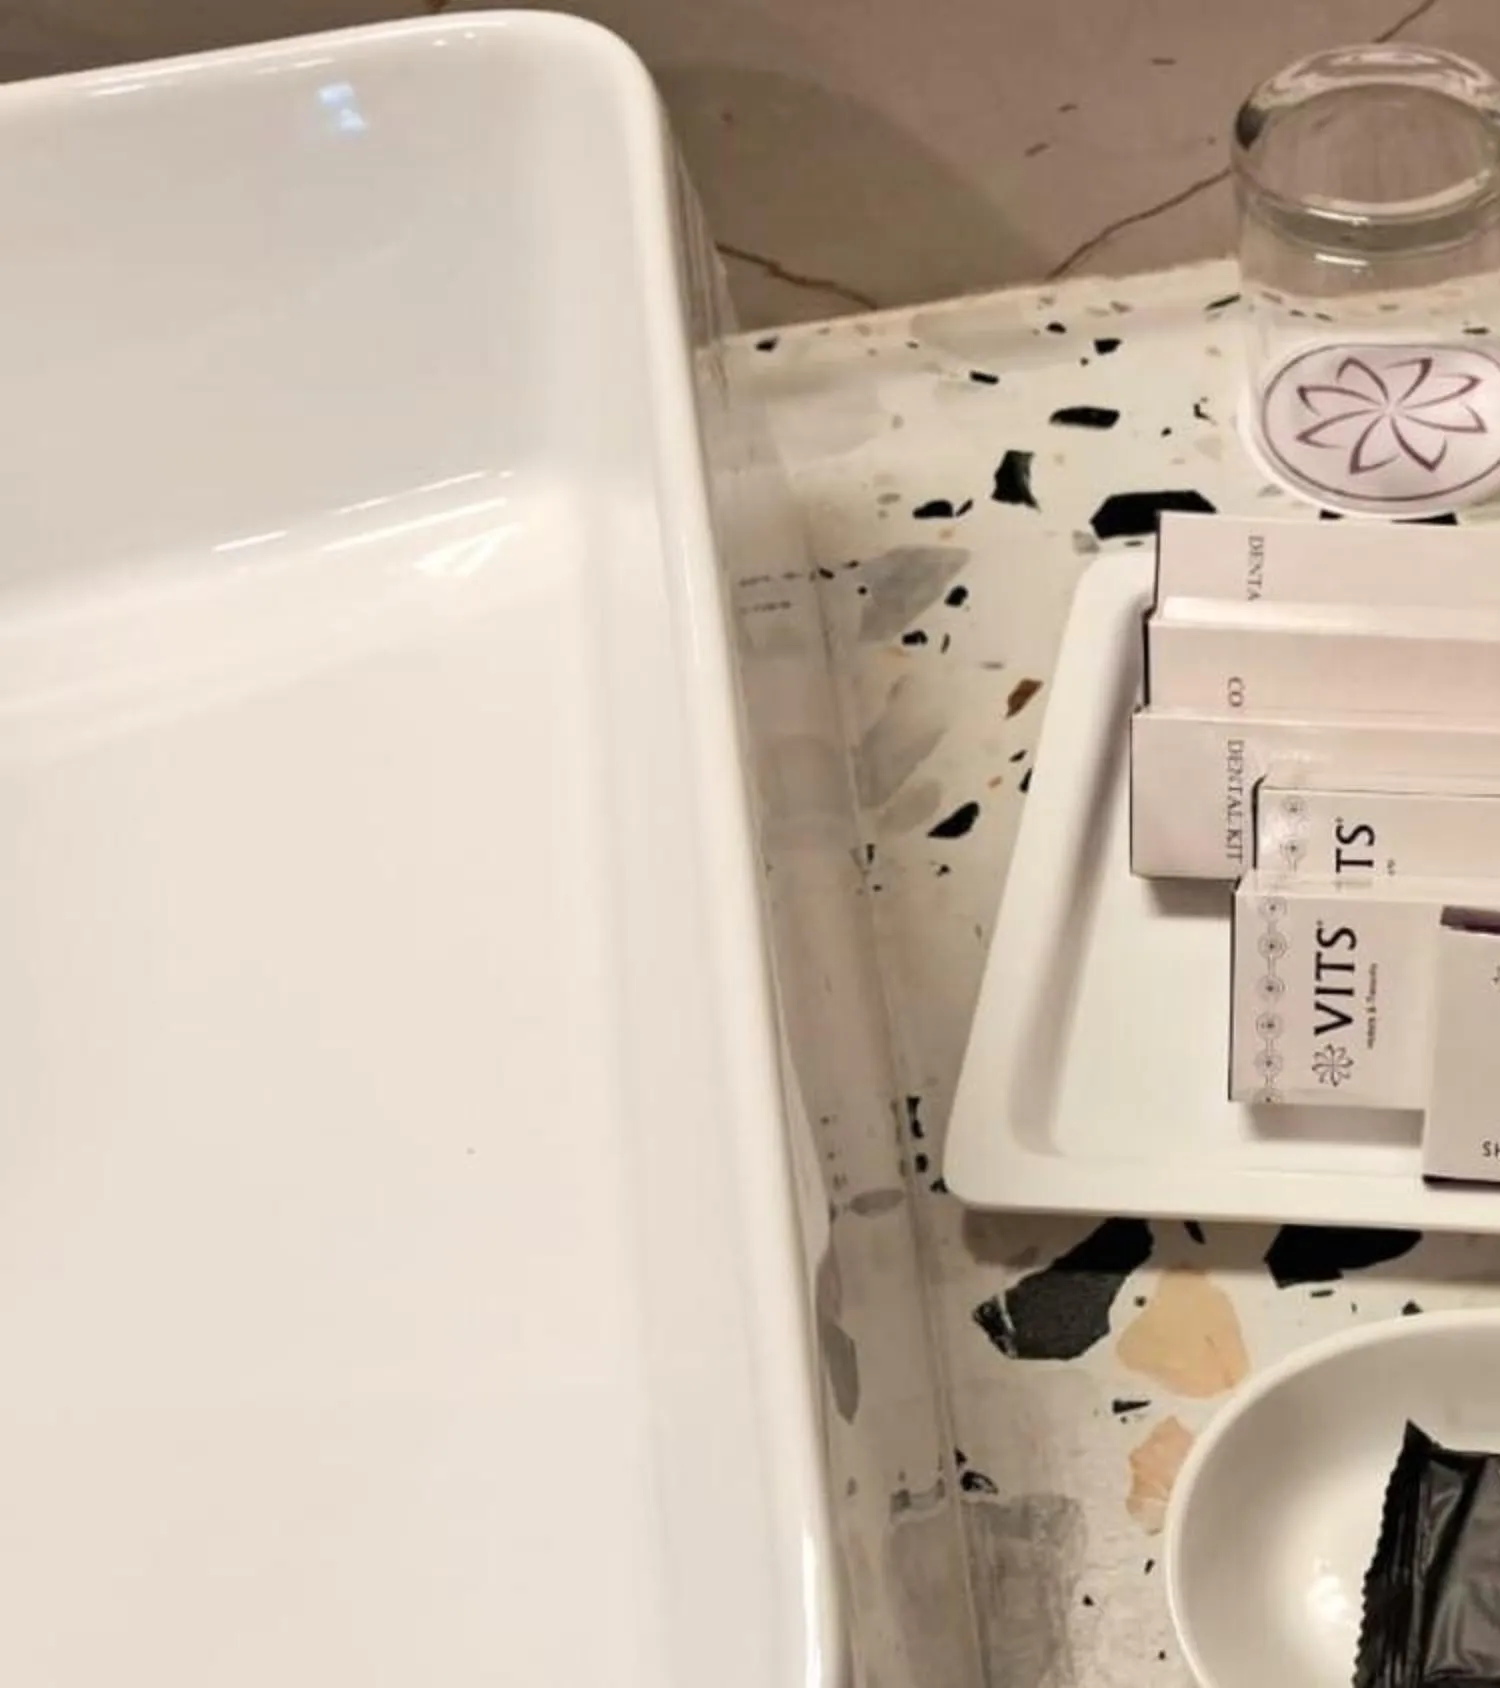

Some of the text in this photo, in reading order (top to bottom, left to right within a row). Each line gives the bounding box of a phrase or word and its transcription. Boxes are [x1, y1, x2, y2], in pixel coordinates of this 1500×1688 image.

[1225, 739, 1245, 864] DENTAL KIT
[1313, 925, 1358, 1037] VITS
